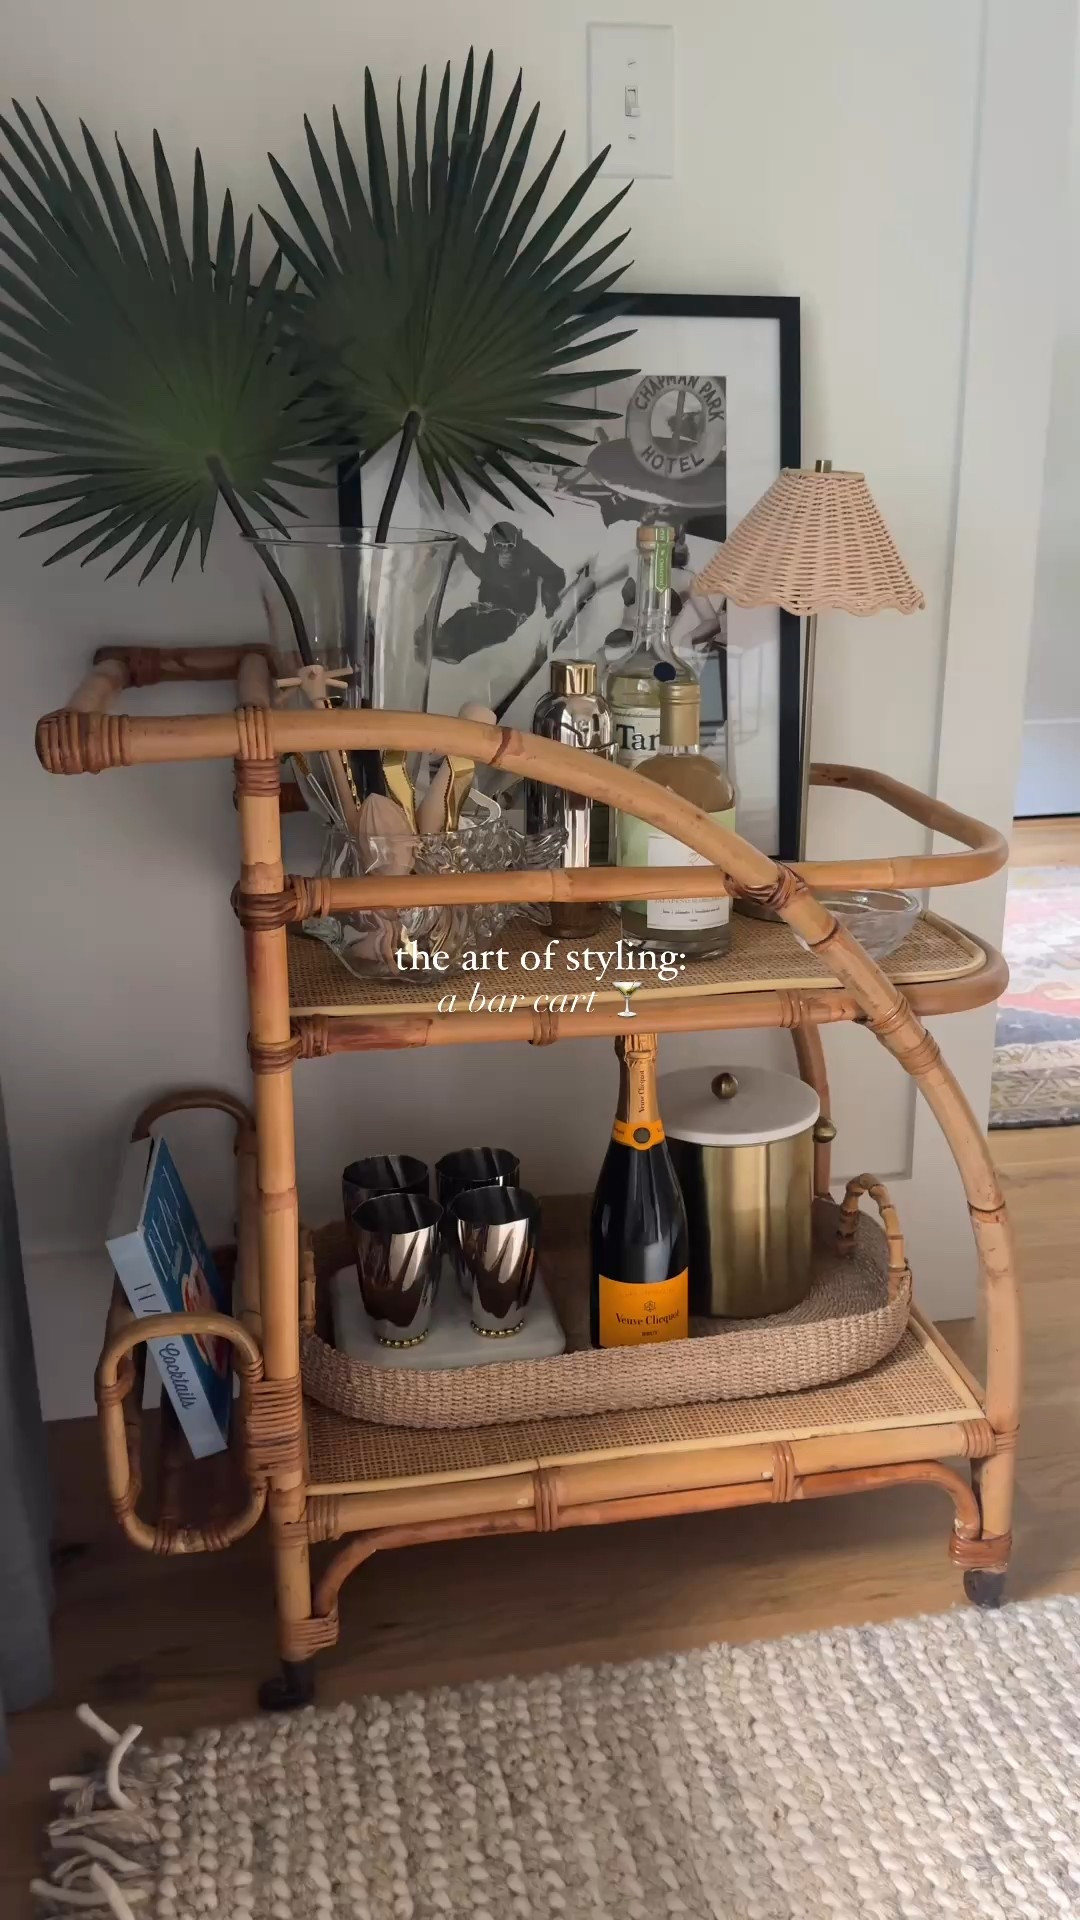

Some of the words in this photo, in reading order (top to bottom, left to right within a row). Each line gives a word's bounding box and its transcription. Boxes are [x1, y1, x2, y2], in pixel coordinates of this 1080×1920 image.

[634, 375, 700, 410] CHAPMAN
[699, 381, 725, 422] PARK
[641, 445, 704, 474] HOTEL
[616, 1312, 643, 1325] Veuve
[645, 1309, 680, 1325] Clicquot
[159, 1342, 197, 1410] Cocktails
